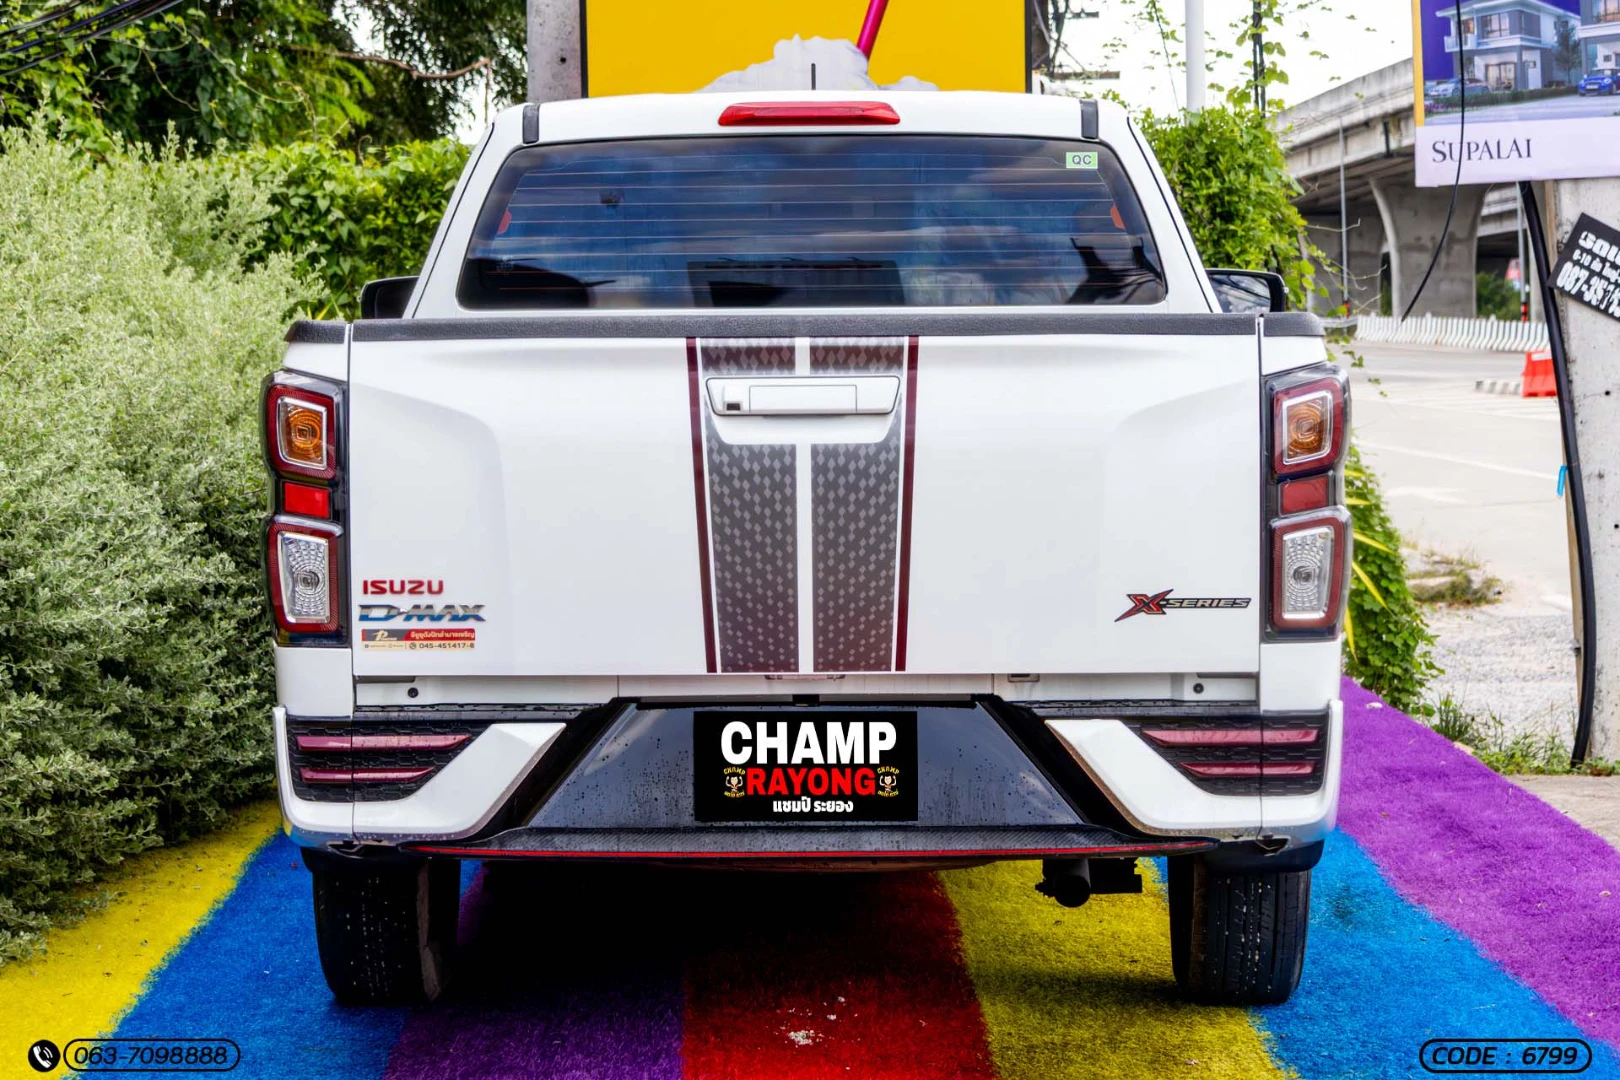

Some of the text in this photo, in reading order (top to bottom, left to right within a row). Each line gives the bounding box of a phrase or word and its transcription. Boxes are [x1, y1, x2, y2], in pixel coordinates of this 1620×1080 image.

[1432, 138, 1532, 163] SUPALAI
[1072, 154, 1092, 166] QC
[362, 579, 444, 595] ISUZU
[358, 604, 486, 622] D-MAX
[1114, 589, 1252, 622] X-SERIES
